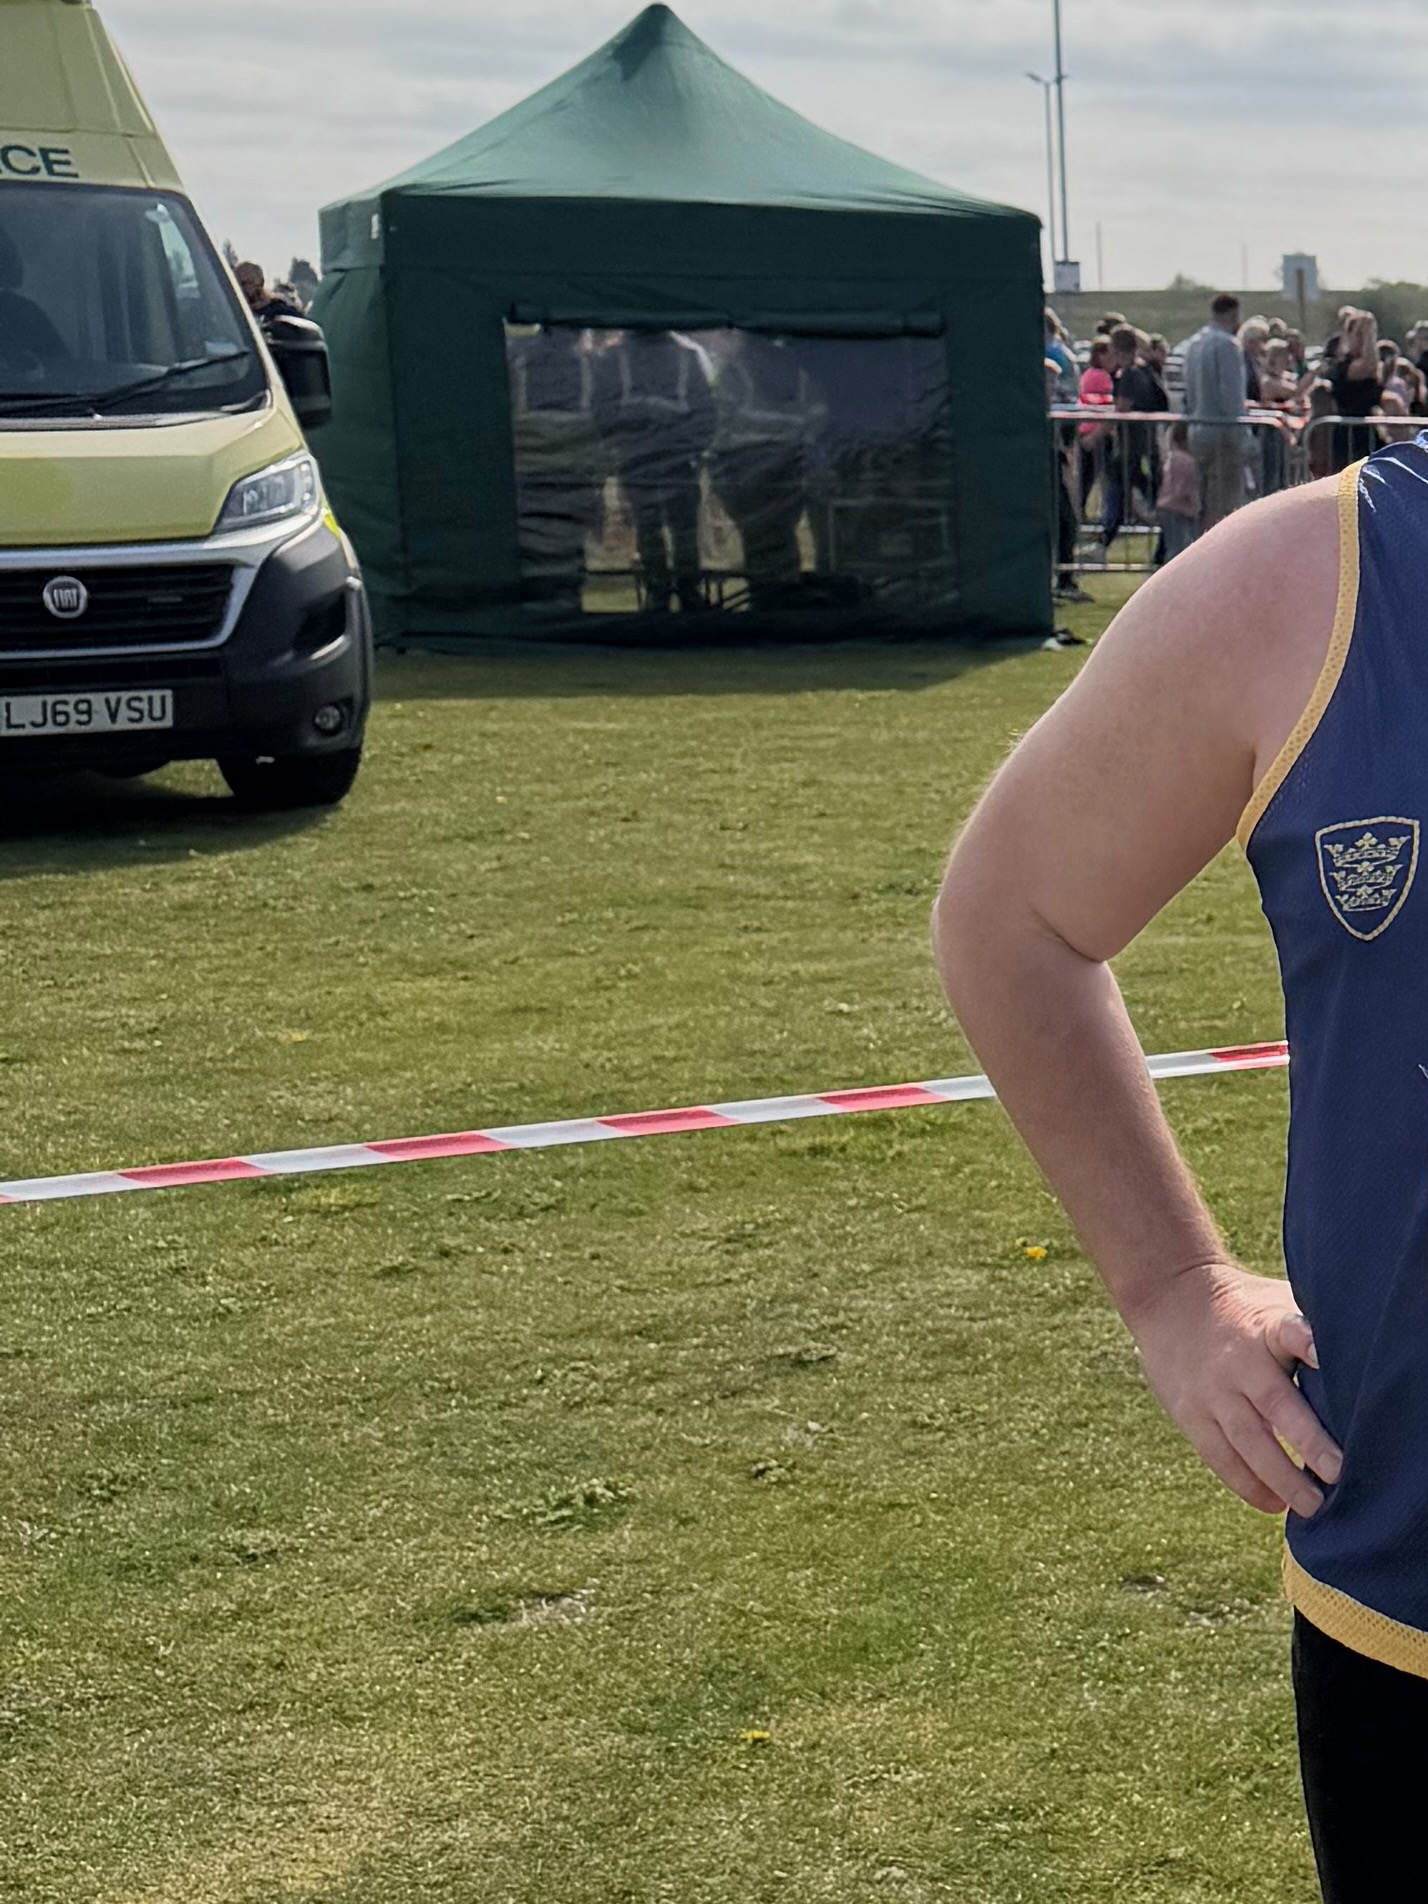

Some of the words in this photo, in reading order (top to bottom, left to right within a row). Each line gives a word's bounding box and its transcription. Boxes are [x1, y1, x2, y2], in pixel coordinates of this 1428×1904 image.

[0, 145, 79, 178] CE
[53, 588, 78, 608] FIAT
[5, 699, 92, 729] LJ69
[105, 695, 166, 724] VSU
